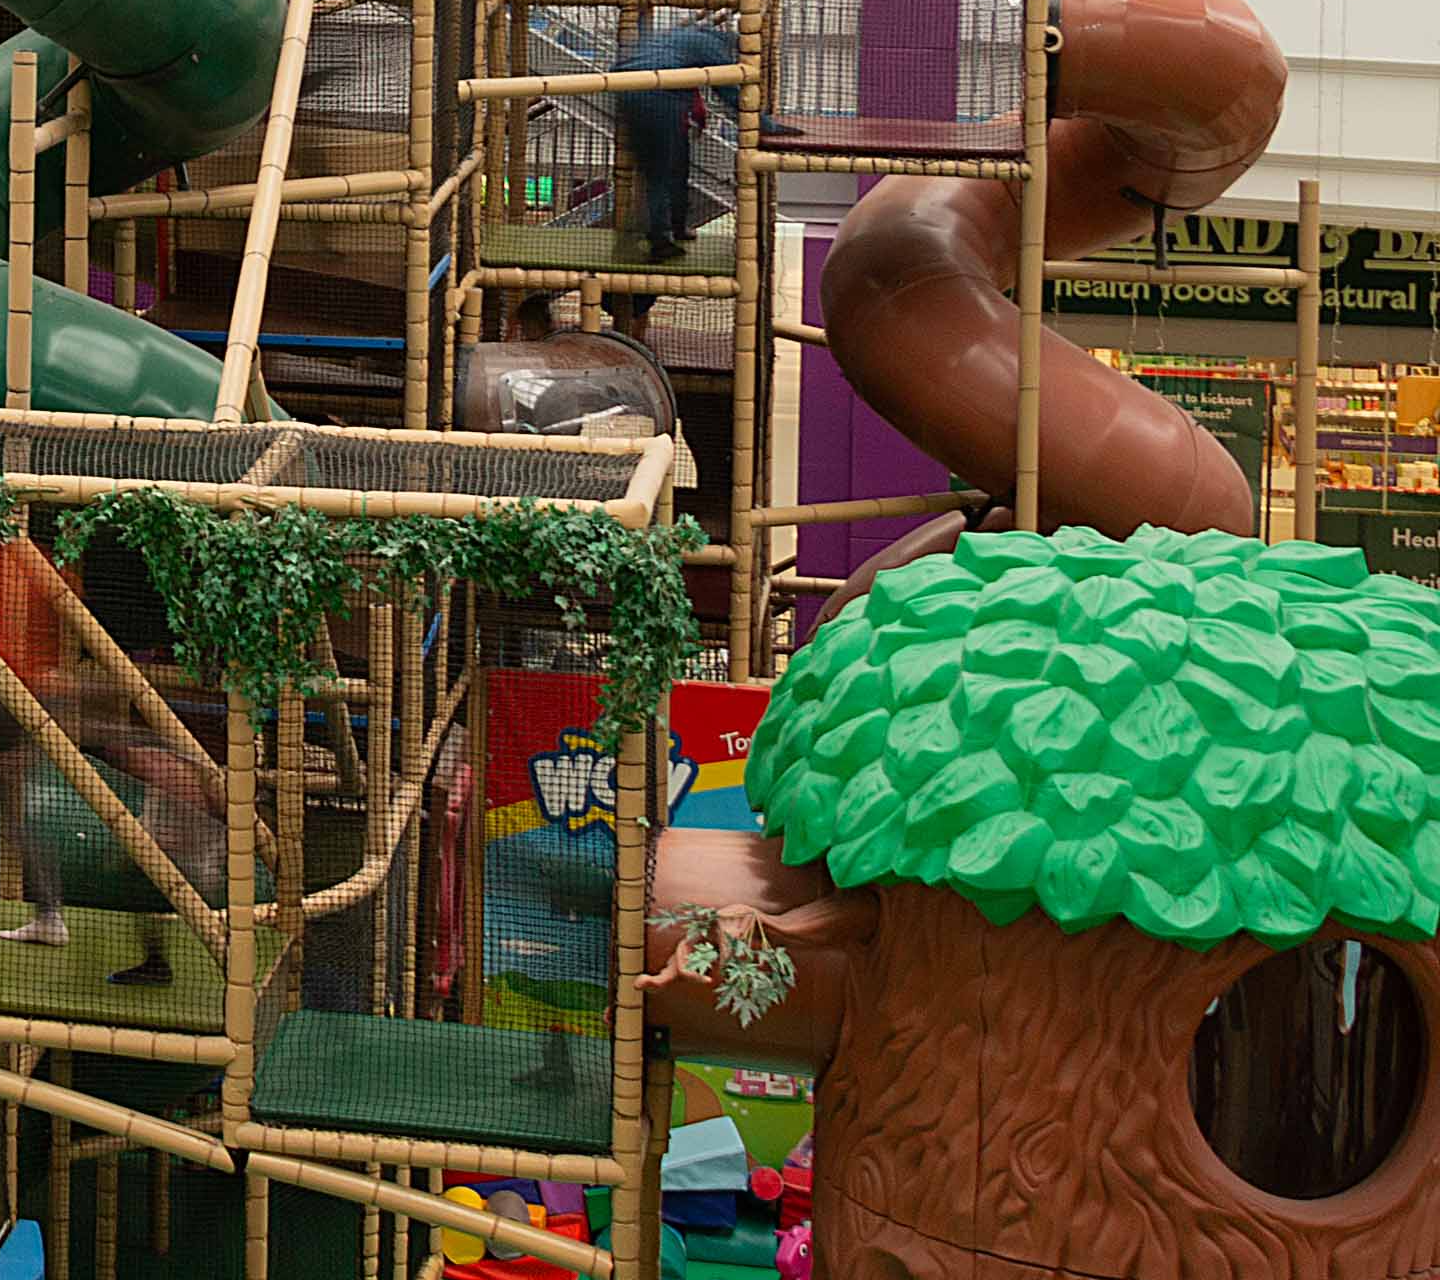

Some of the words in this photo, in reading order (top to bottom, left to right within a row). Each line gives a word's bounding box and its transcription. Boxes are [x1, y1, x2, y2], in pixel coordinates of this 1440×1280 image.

[1054, 277, 1151, 302] health
[1161, 282, 1250, 305] foods
[1316, 283, 1416, 312] atural
